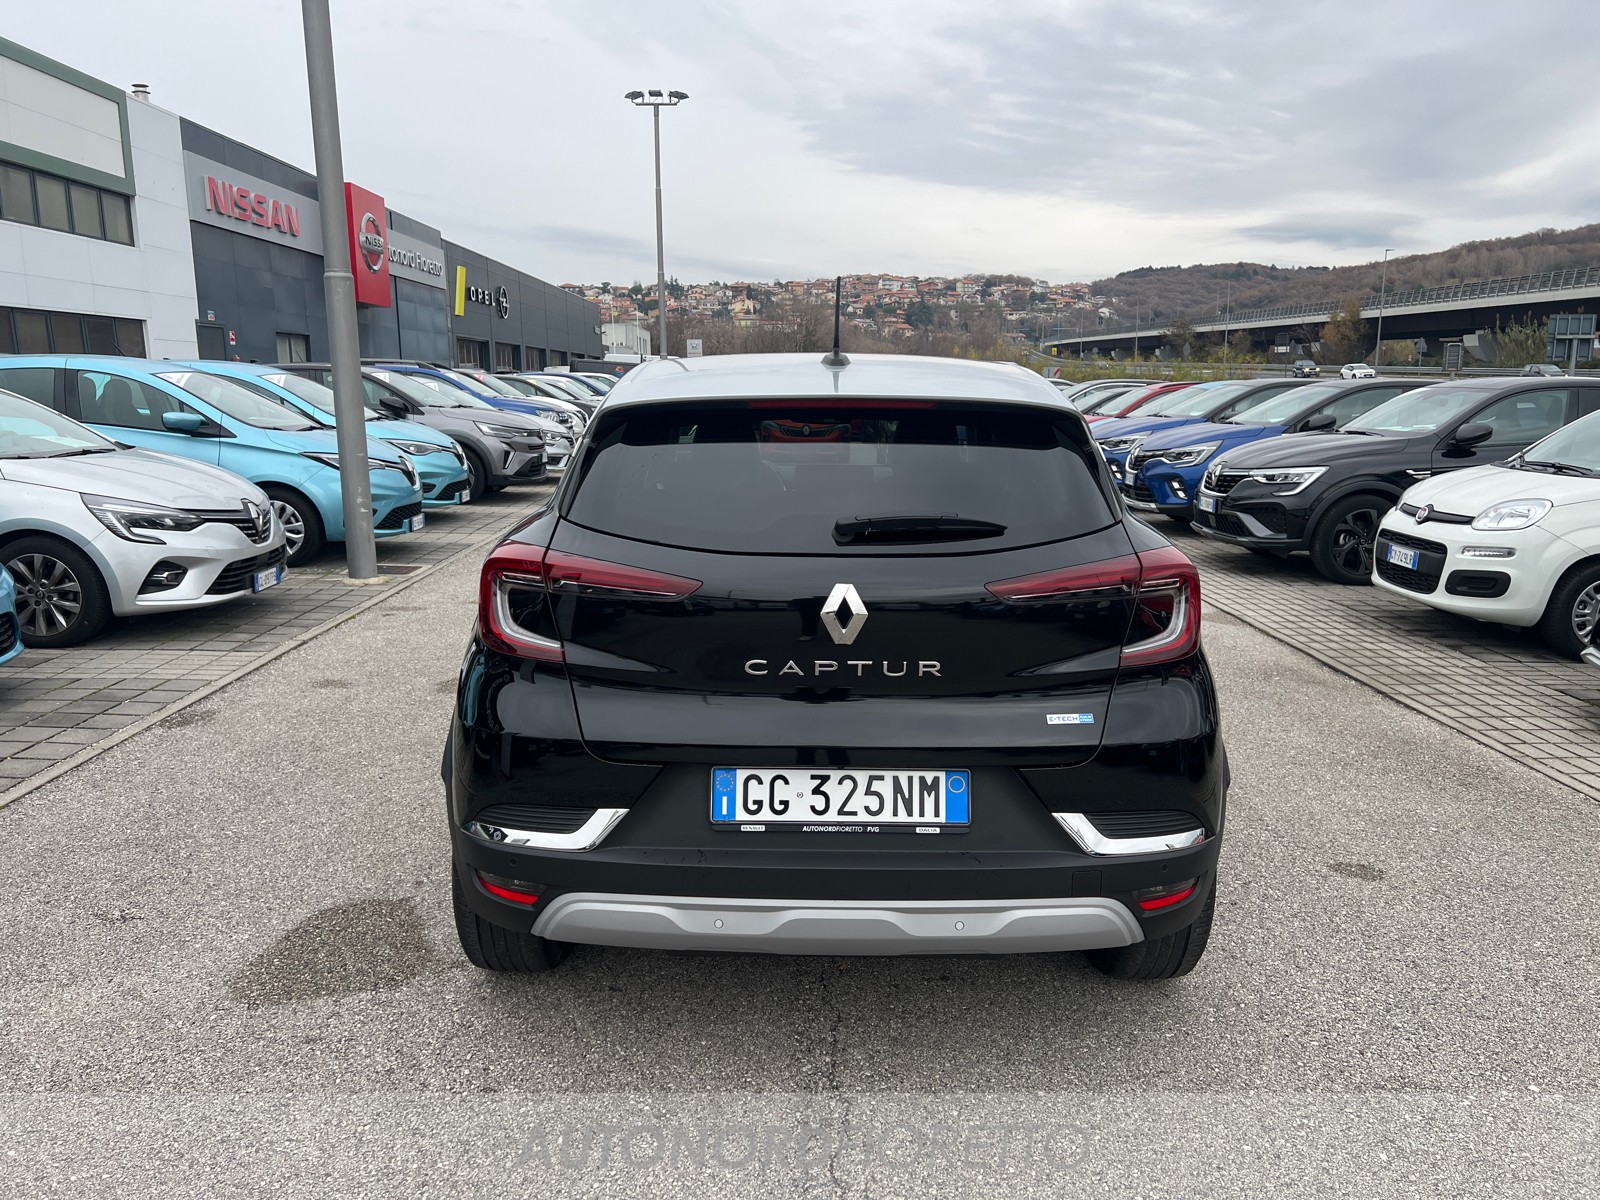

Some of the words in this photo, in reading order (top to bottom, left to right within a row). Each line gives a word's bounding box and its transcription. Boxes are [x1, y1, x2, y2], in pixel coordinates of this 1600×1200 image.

[204, 176, 300, 237] NISSAN
[416, 252, 443, 276] Fioretto
[470, 286, 496, 306] OPEL
[744, 660, 942, 677] CAPTUR
[742, 774, 790, 816] GG
[809, 774, 940, 818] 325NM
